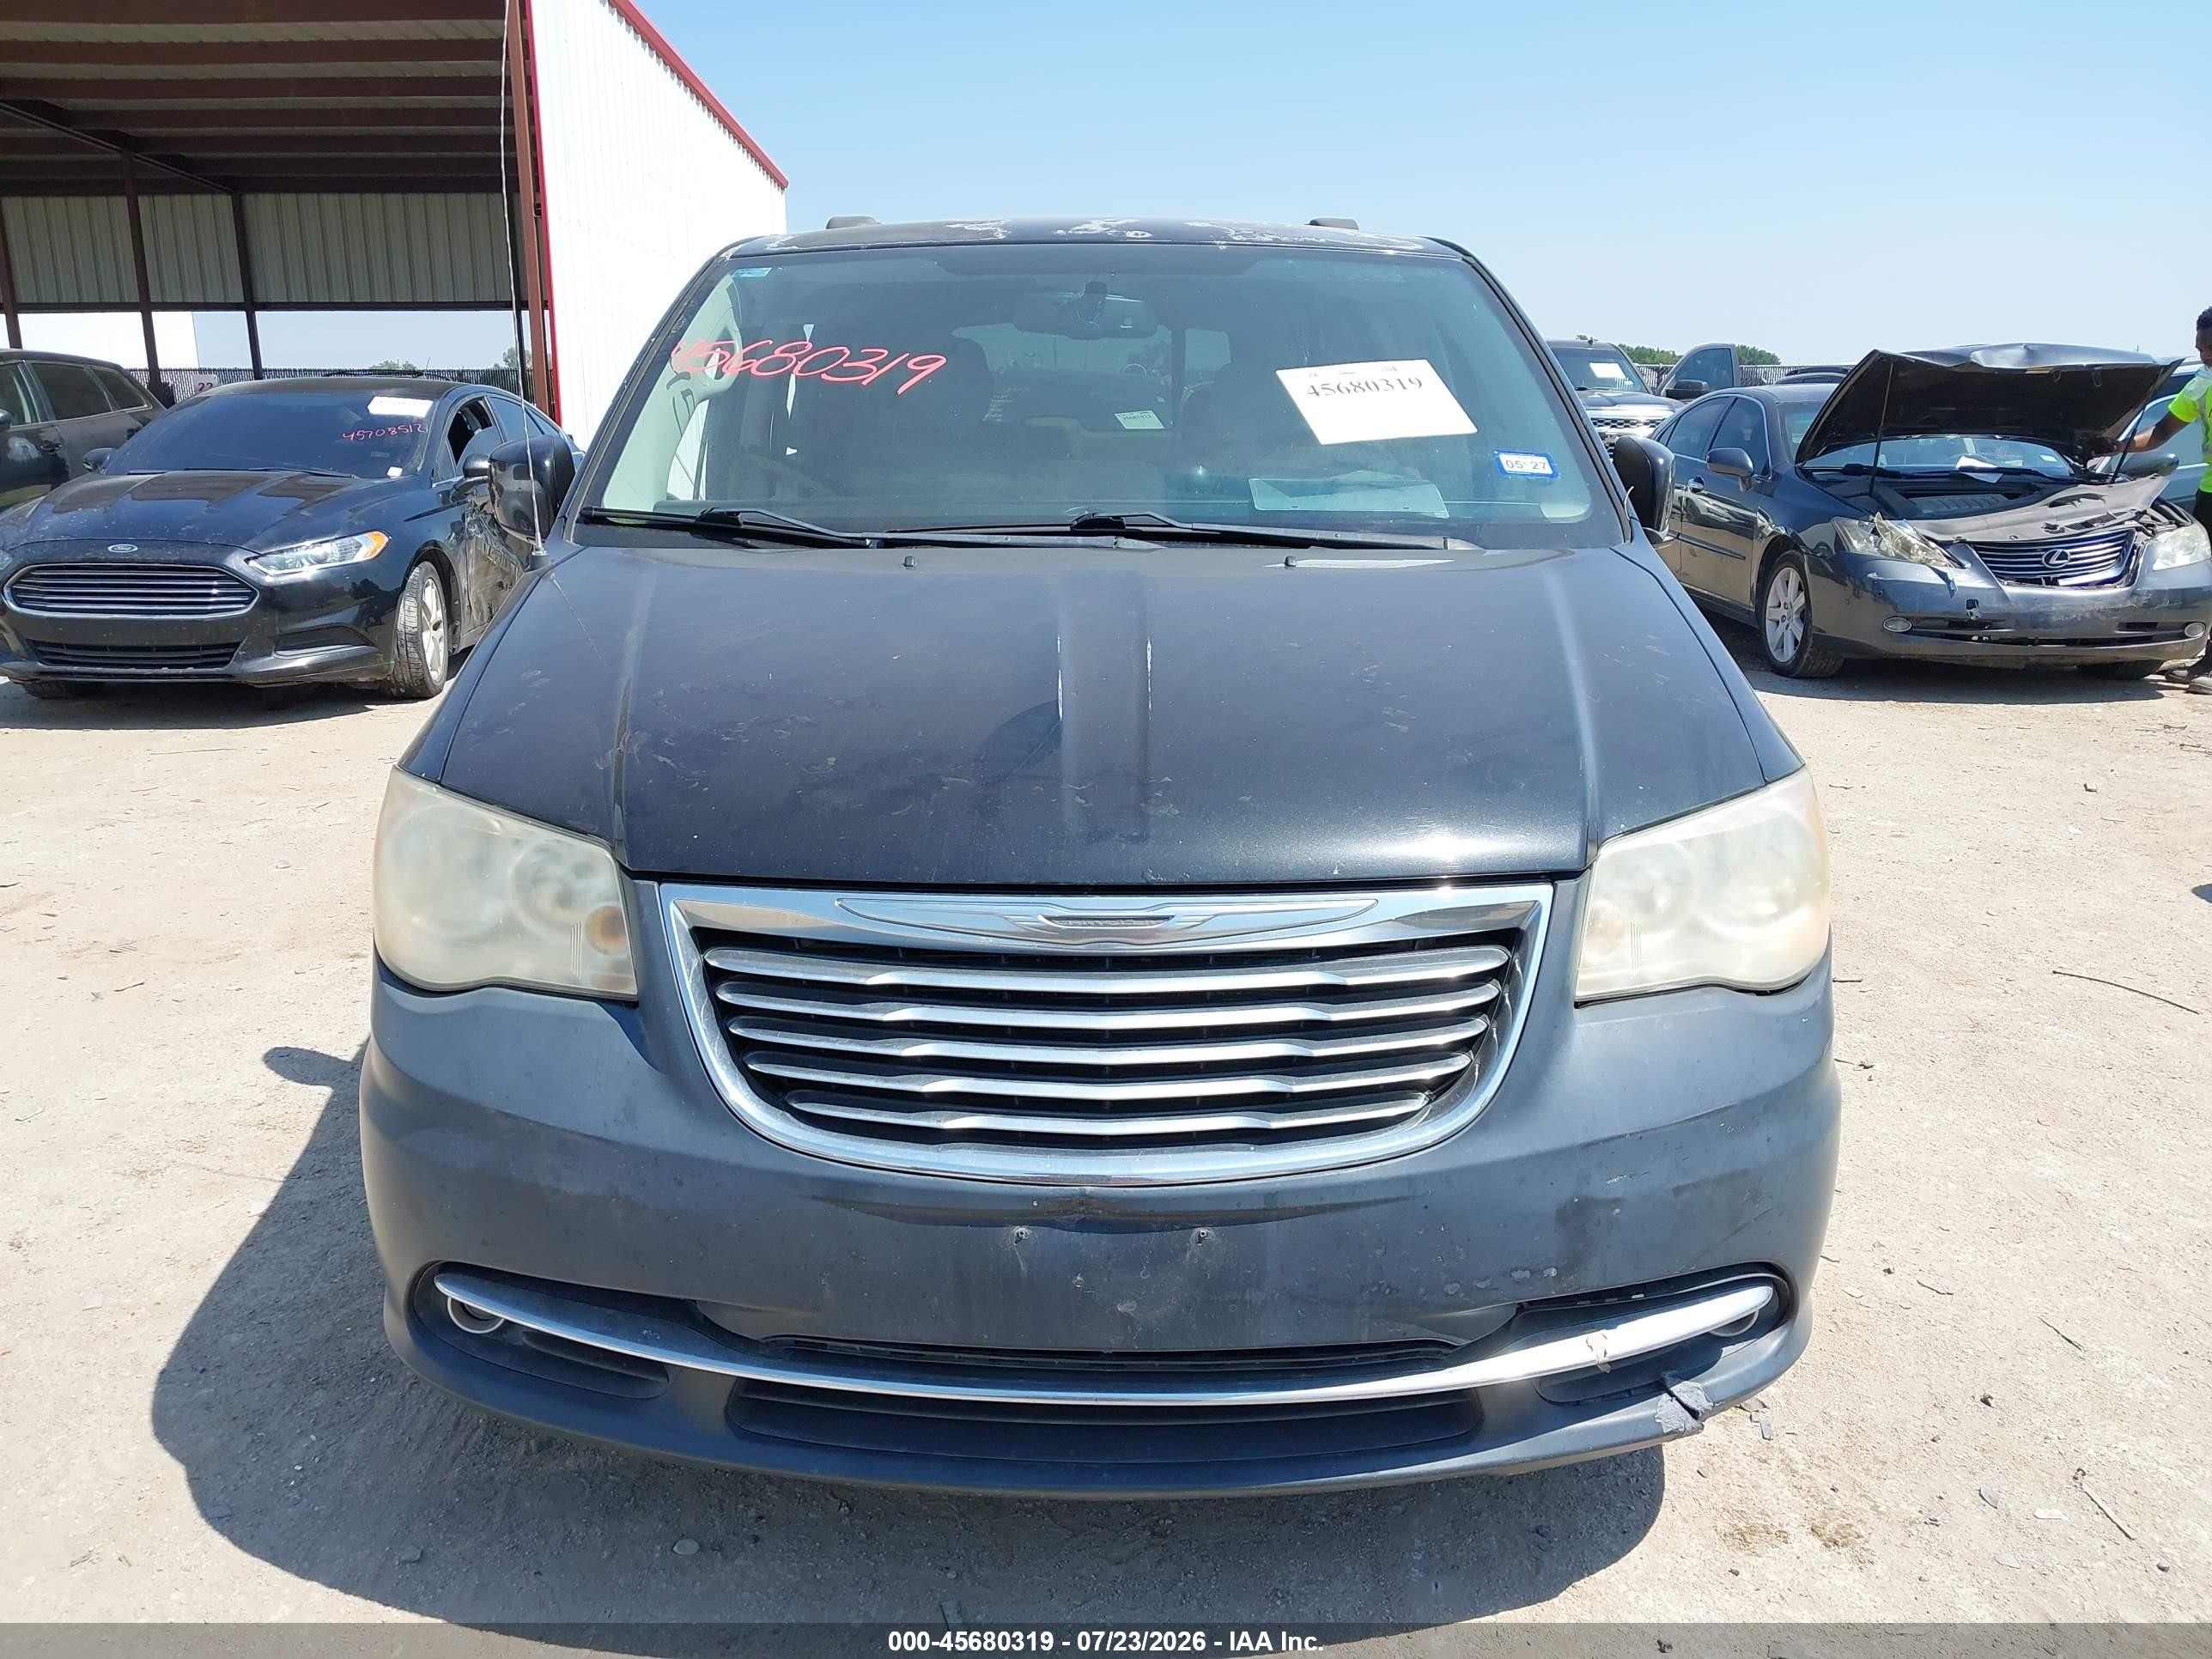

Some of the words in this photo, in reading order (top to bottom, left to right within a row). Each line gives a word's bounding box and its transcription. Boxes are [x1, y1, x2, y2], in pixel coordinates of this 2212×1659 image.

[670, 339, 946, 395] 45680319
[1306, 377, 1423, 397] 45680319
[343, 423, 427, 441] 45708512
[1505, 459, 1523, 469] 05
[1530, 460, 1547, 470] 27
